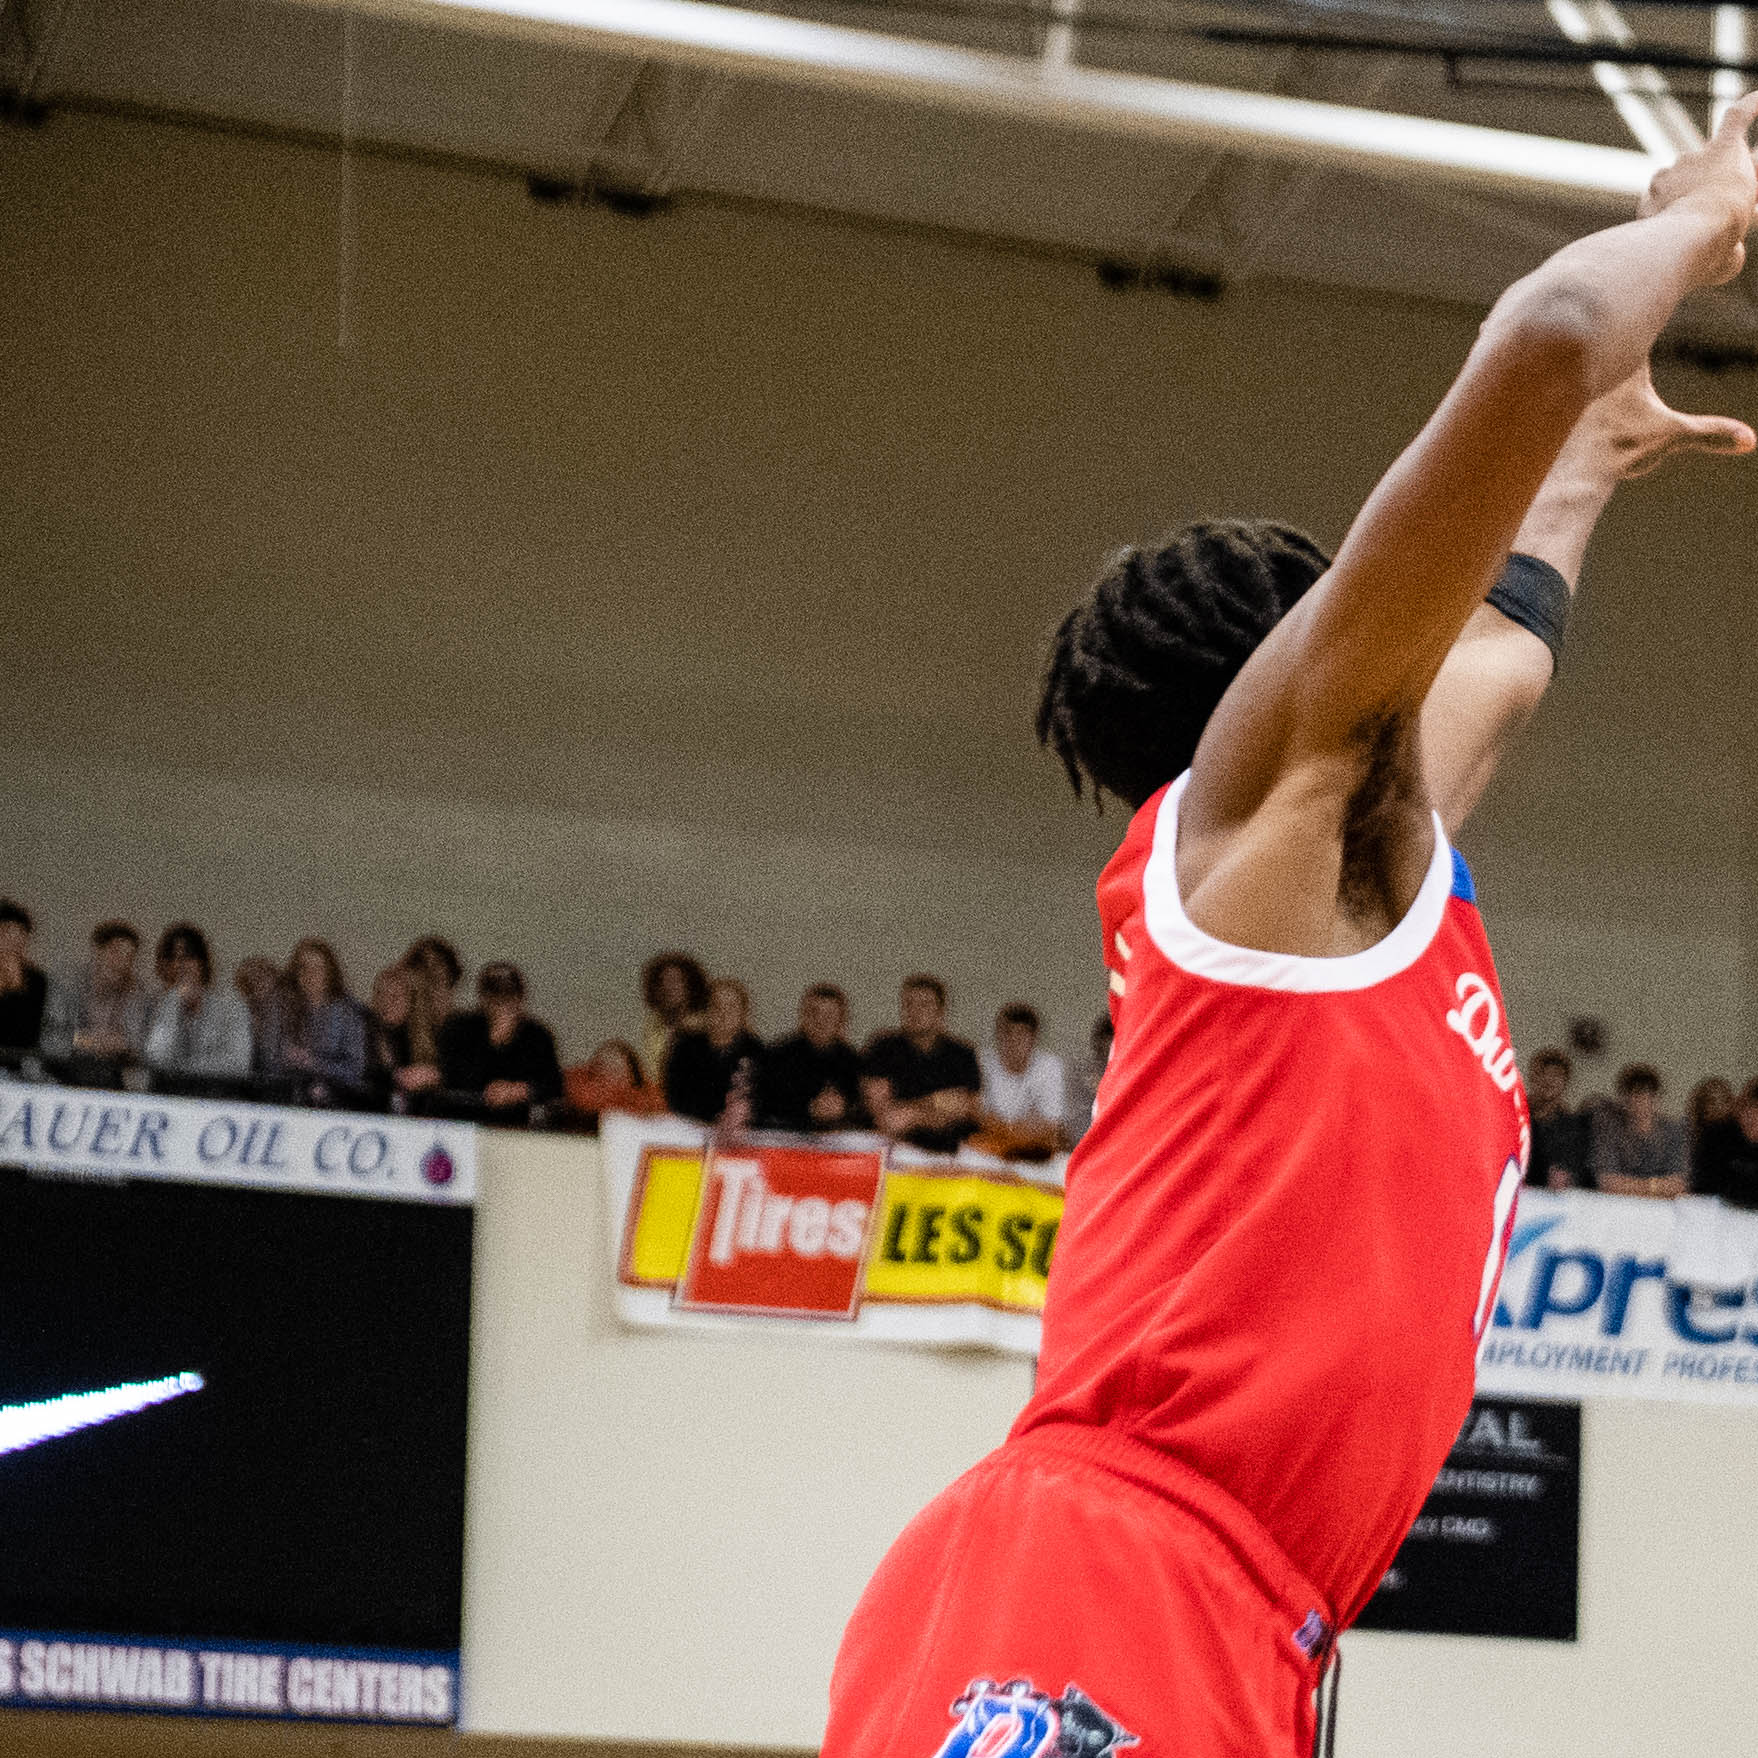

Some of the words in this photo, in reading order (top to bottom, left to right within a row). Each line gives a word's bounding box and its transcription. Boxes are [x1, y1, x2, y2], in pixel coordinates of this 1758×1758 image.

[197, 1114, 289, 1170] OIL
[314, 1123, 396, 1180] CO.
[708, 1158, 870, 1267] Tires
[880, 1203, 985, 1264] LES
[18, 1641, 193, 1701] SCHWAB
[200, 1651, 285, 1711] TIRE
[286, 1656, 453, 1721] CENTERS
